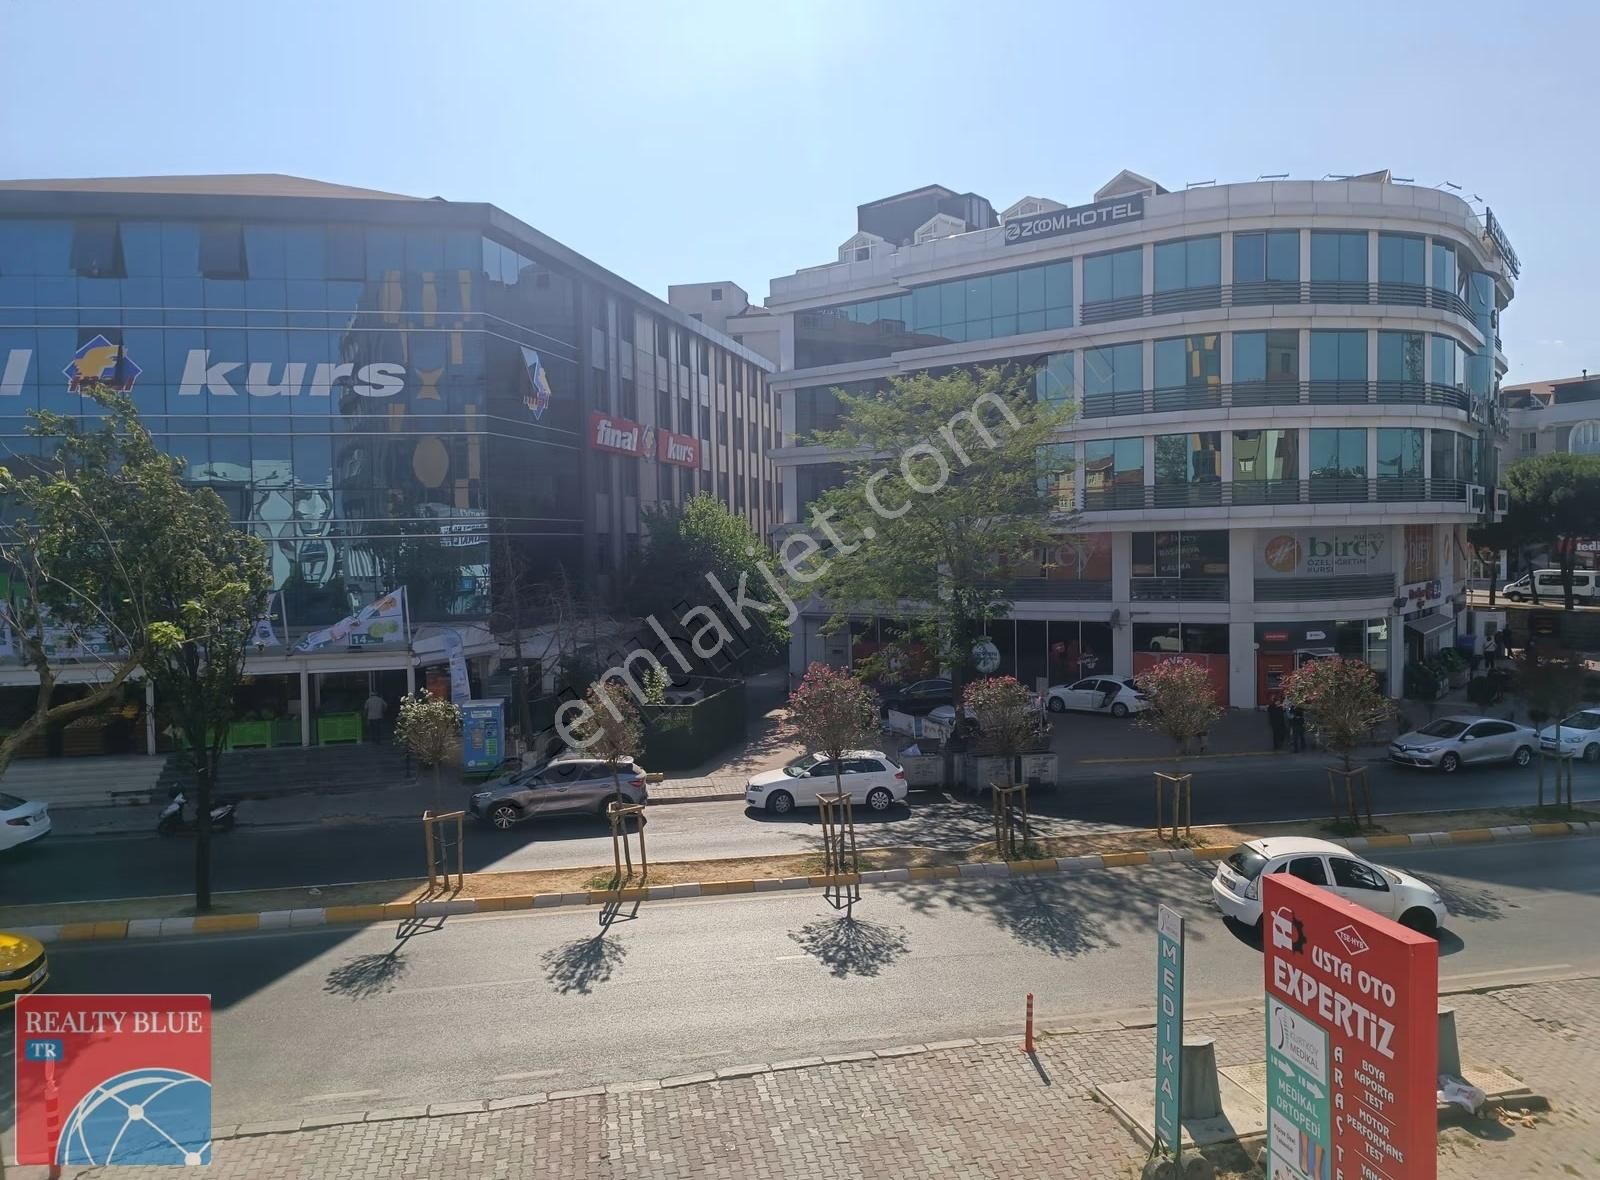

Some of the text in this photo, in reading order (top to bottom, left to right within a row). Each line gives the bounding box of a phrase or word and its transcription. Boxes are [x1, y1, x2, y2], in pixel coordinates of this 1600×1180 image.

[178, 349, 406, 397] kurs
[596, 419, 694, 463] final kurs
[1308, 536, 1384, 560] birey
[352, 635, 367, 644] 14
[1312, 945, 1396, 1008] USTA OTO
[1161, 938, 1177, 1127] MEDİKAL
[1354, 1069, 1394, 1103] KAPORTA
[1361, 1059, 1385, 1082] BOYA
[1278, 1078, 1319, 1118] MEDİKAL
[1334, 1046, 1344, 1135] ARAÇ
[1364, 1089, 1385, 1111] TEST
[1276, 1095, 1321, 1139] ORTOPEDİ
[1359, 1107, 1390, 1139] MOTOR
[1346, 1113, 1404, 1163] PERFORMANS
[1364, 1141, 1385, 1164] TEST
[1360, 1163, 1382, 1180] YAN
